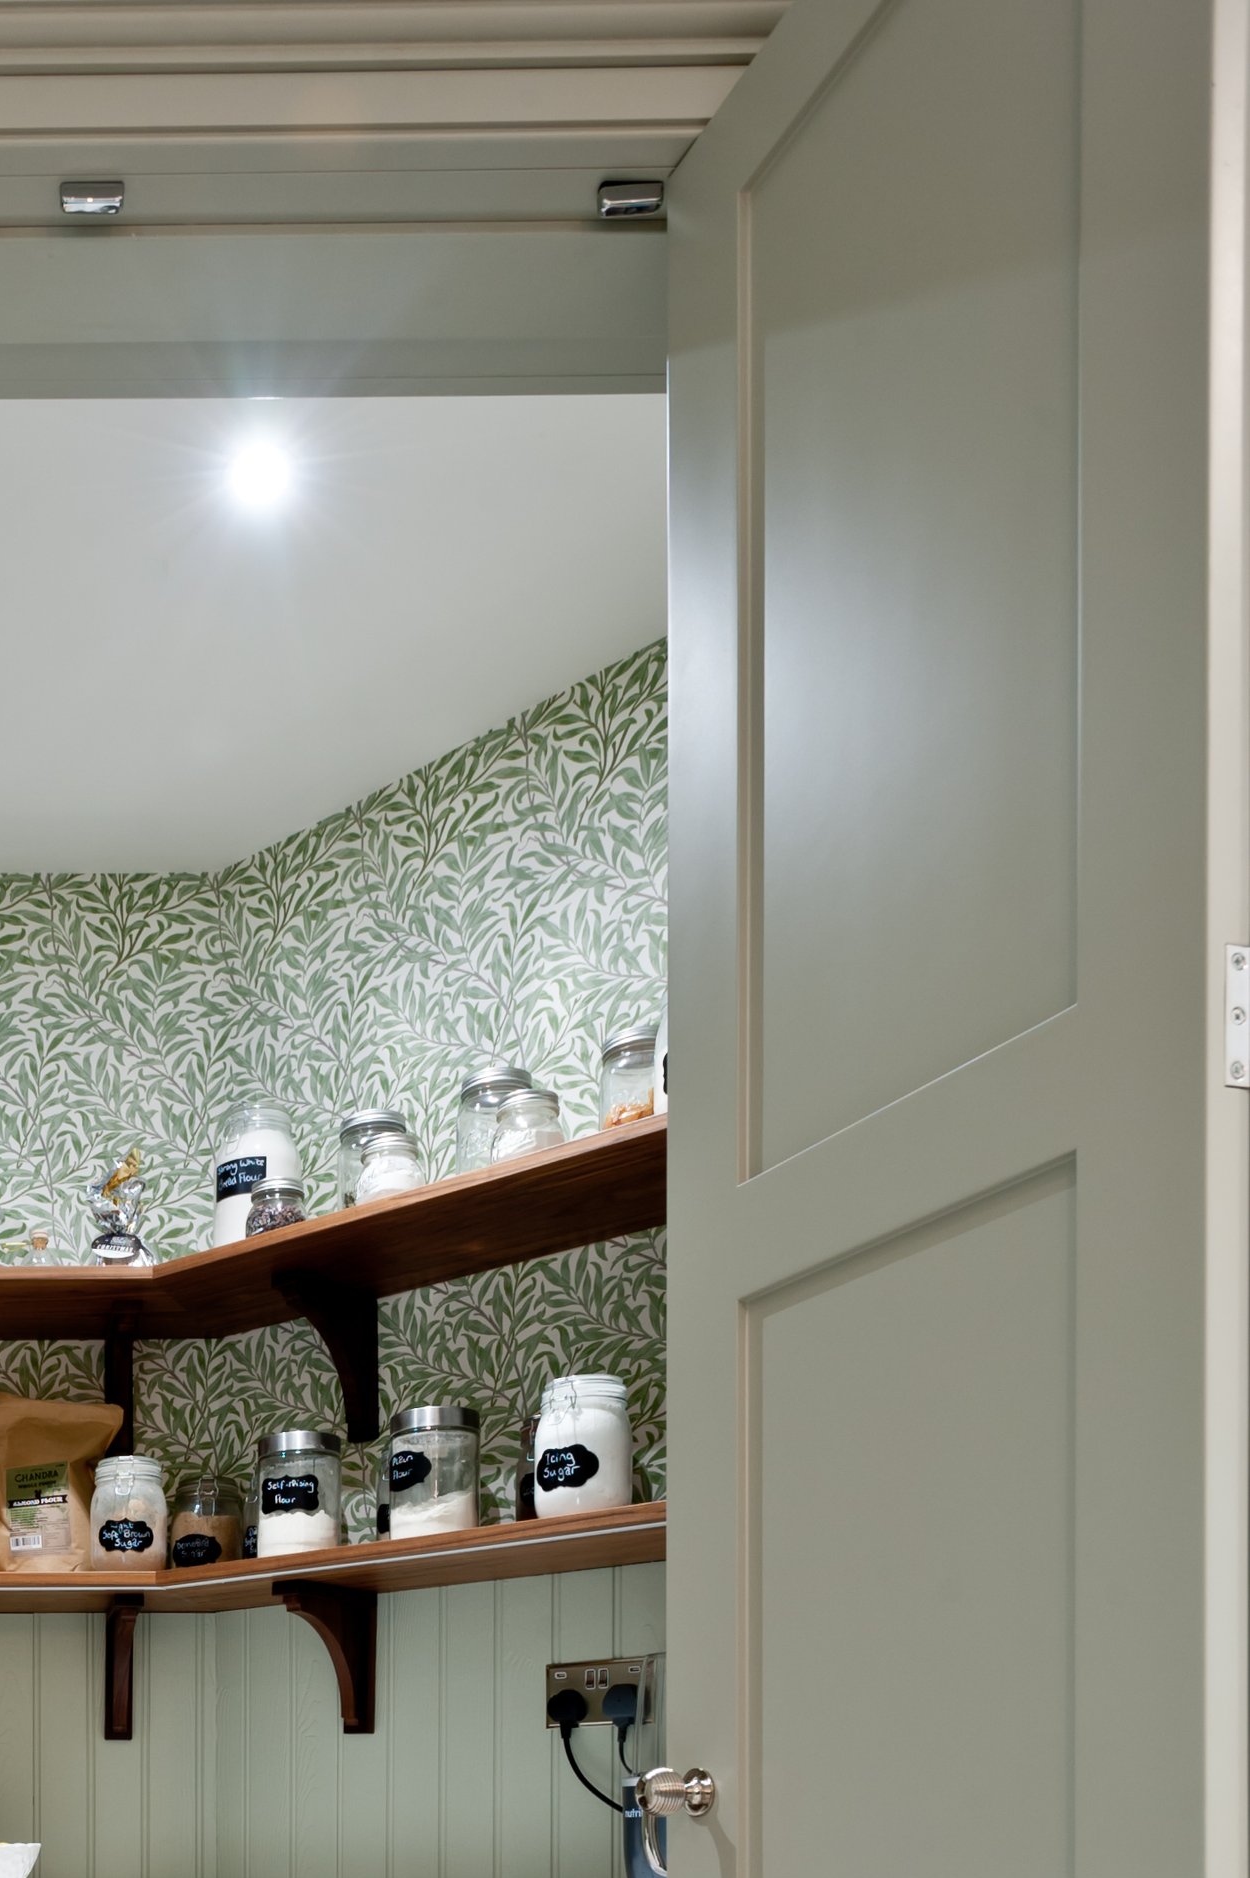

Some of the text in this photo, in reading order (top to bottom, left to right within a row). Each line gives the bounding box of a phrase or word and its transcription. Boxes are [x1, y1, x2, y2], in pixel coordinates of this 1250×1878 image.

[240, 1158, 265, 1168] White
[238, 1172, 263, 1184] Flour
[544, 1452, 577, 1467] Icing
[14, 1469, 59, 1483] CHANDRA
[542, 1465, 581, 1482] Sugar
[40, 1496, 63, 1505] FLOUR
[123, 1529, 151, 1539] Brown
[114, 1538, 143, 1550] Sugar
